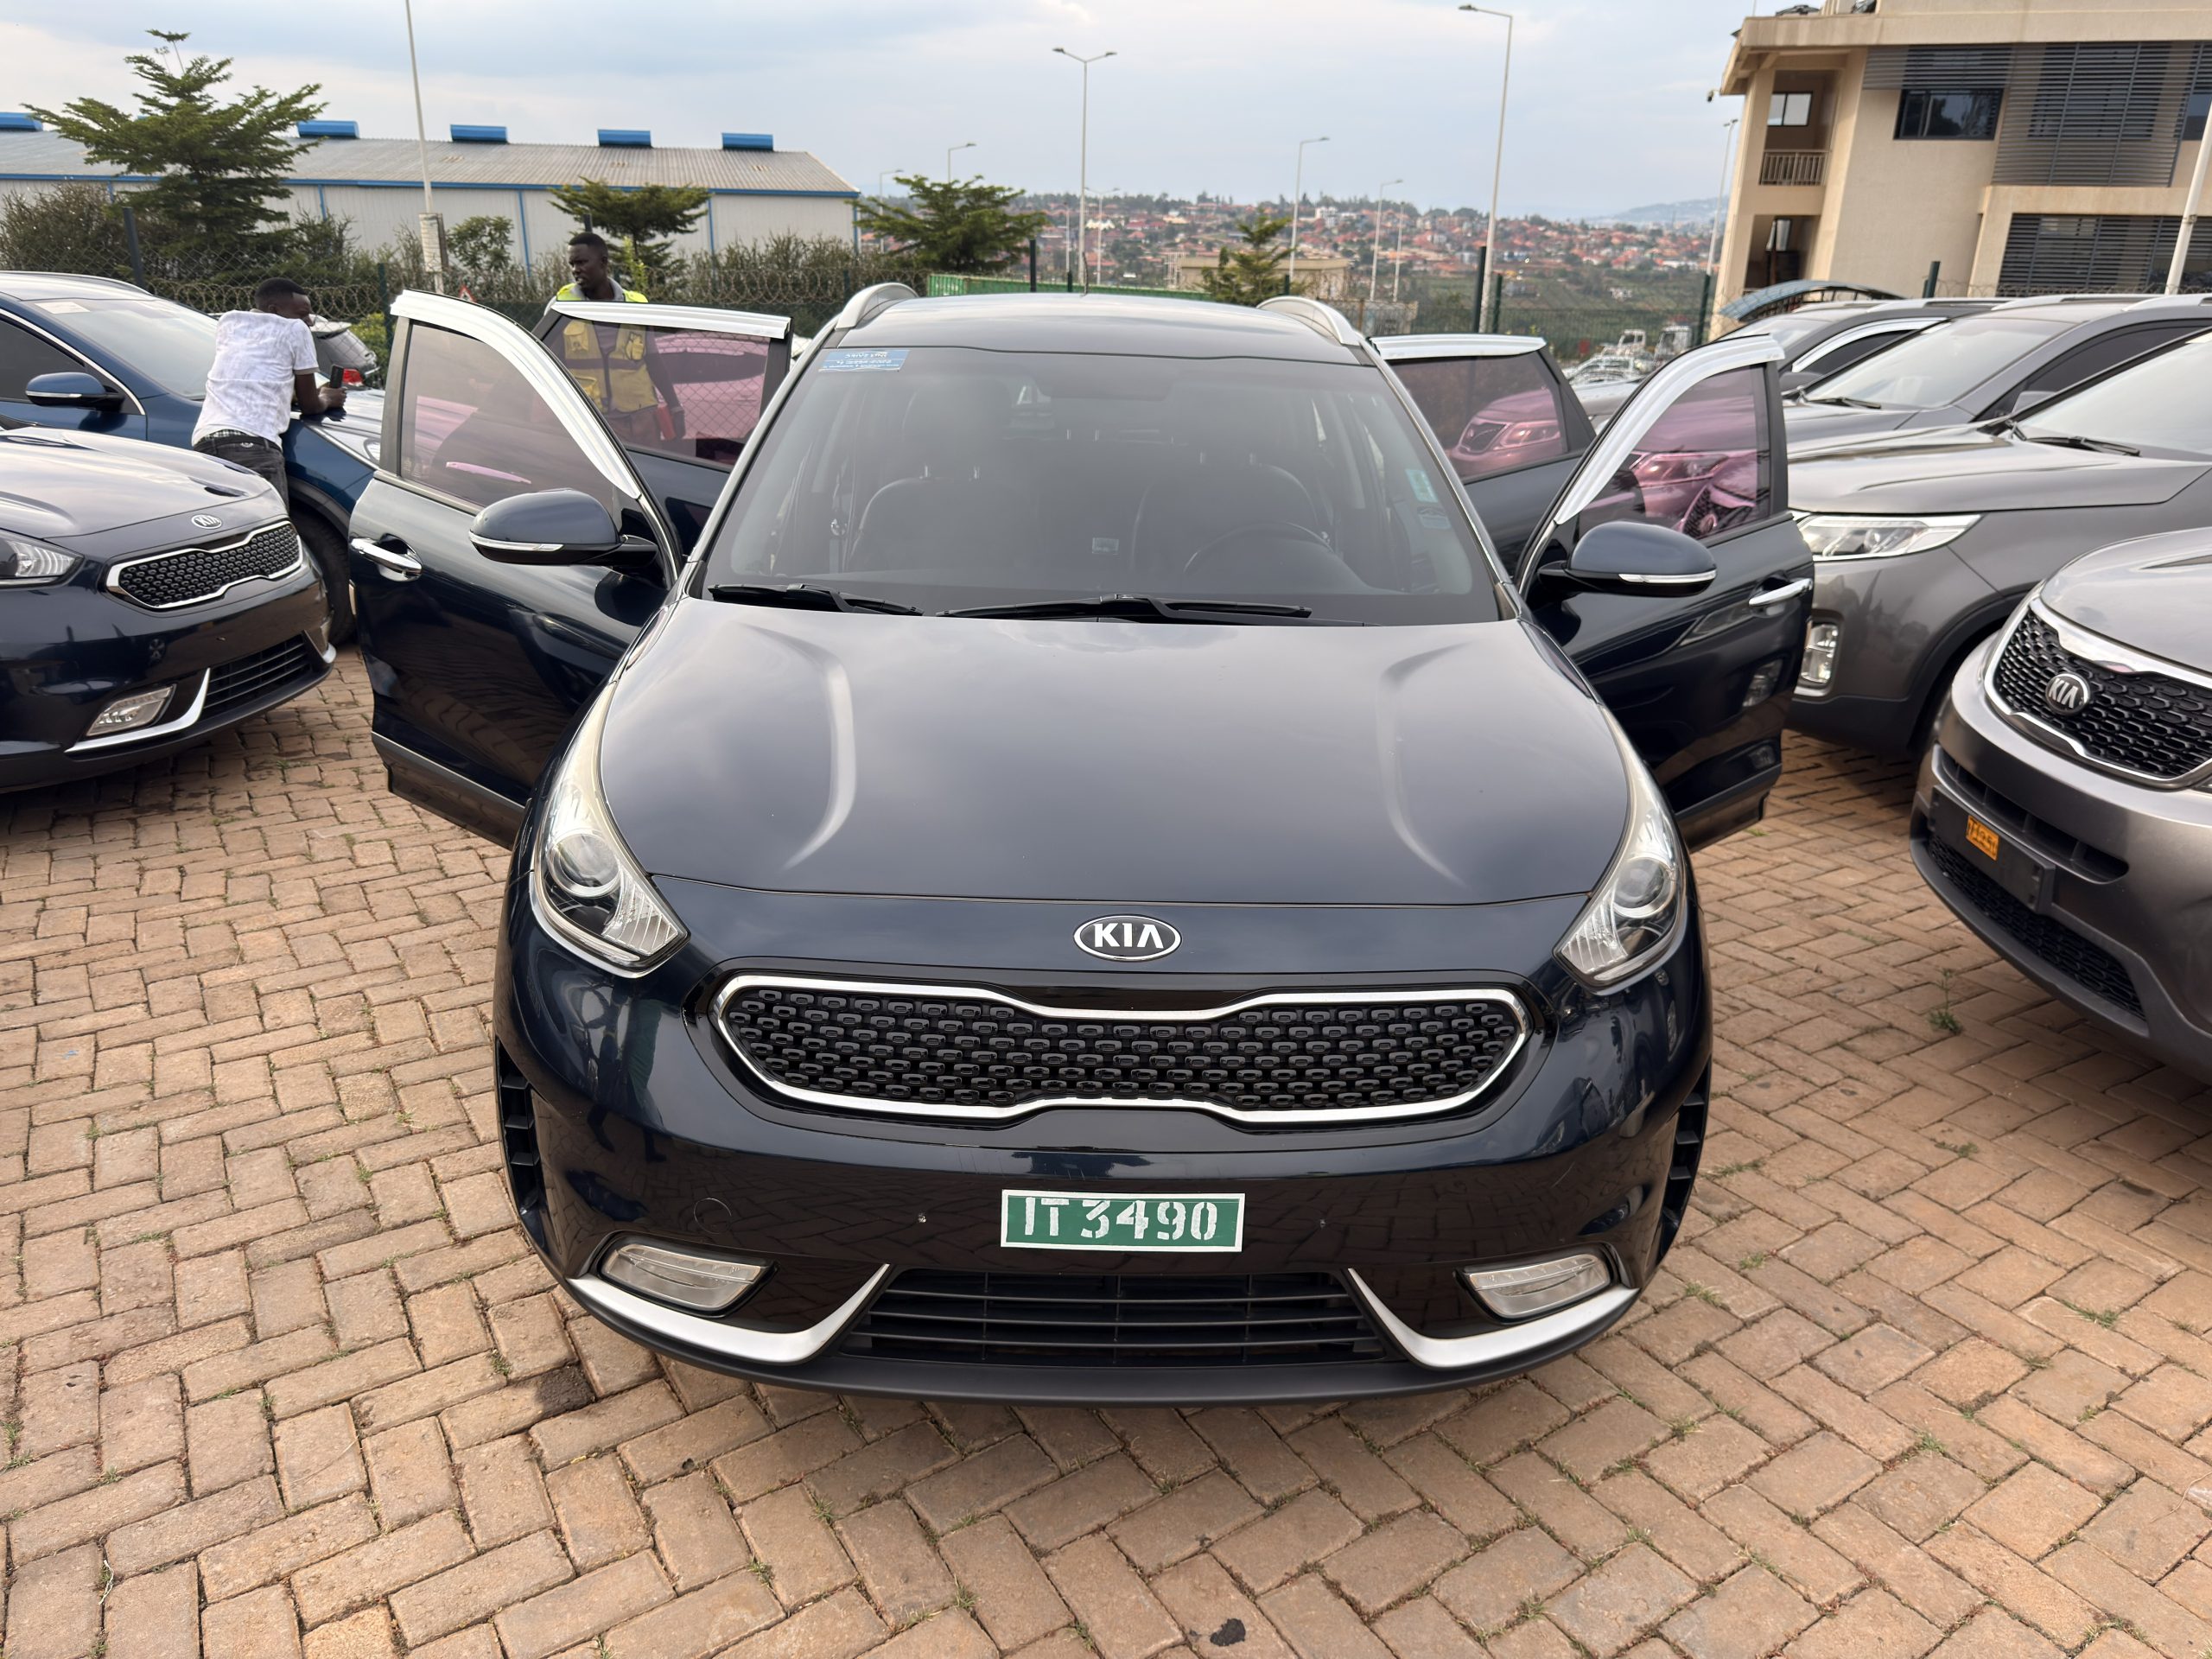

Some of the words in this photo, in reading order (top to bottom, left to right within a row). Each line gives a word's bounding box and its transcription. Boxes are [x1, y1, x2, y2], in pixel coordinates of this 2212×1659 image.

[194, 516, 220, 526] KIA
[2048, 677, 2079, 709] KIA
[1093, 922, 1164, 949] KIA
[1024, 1196, 1070, 1236] IT
[1080, 1199, 1218, 1241] 3490
